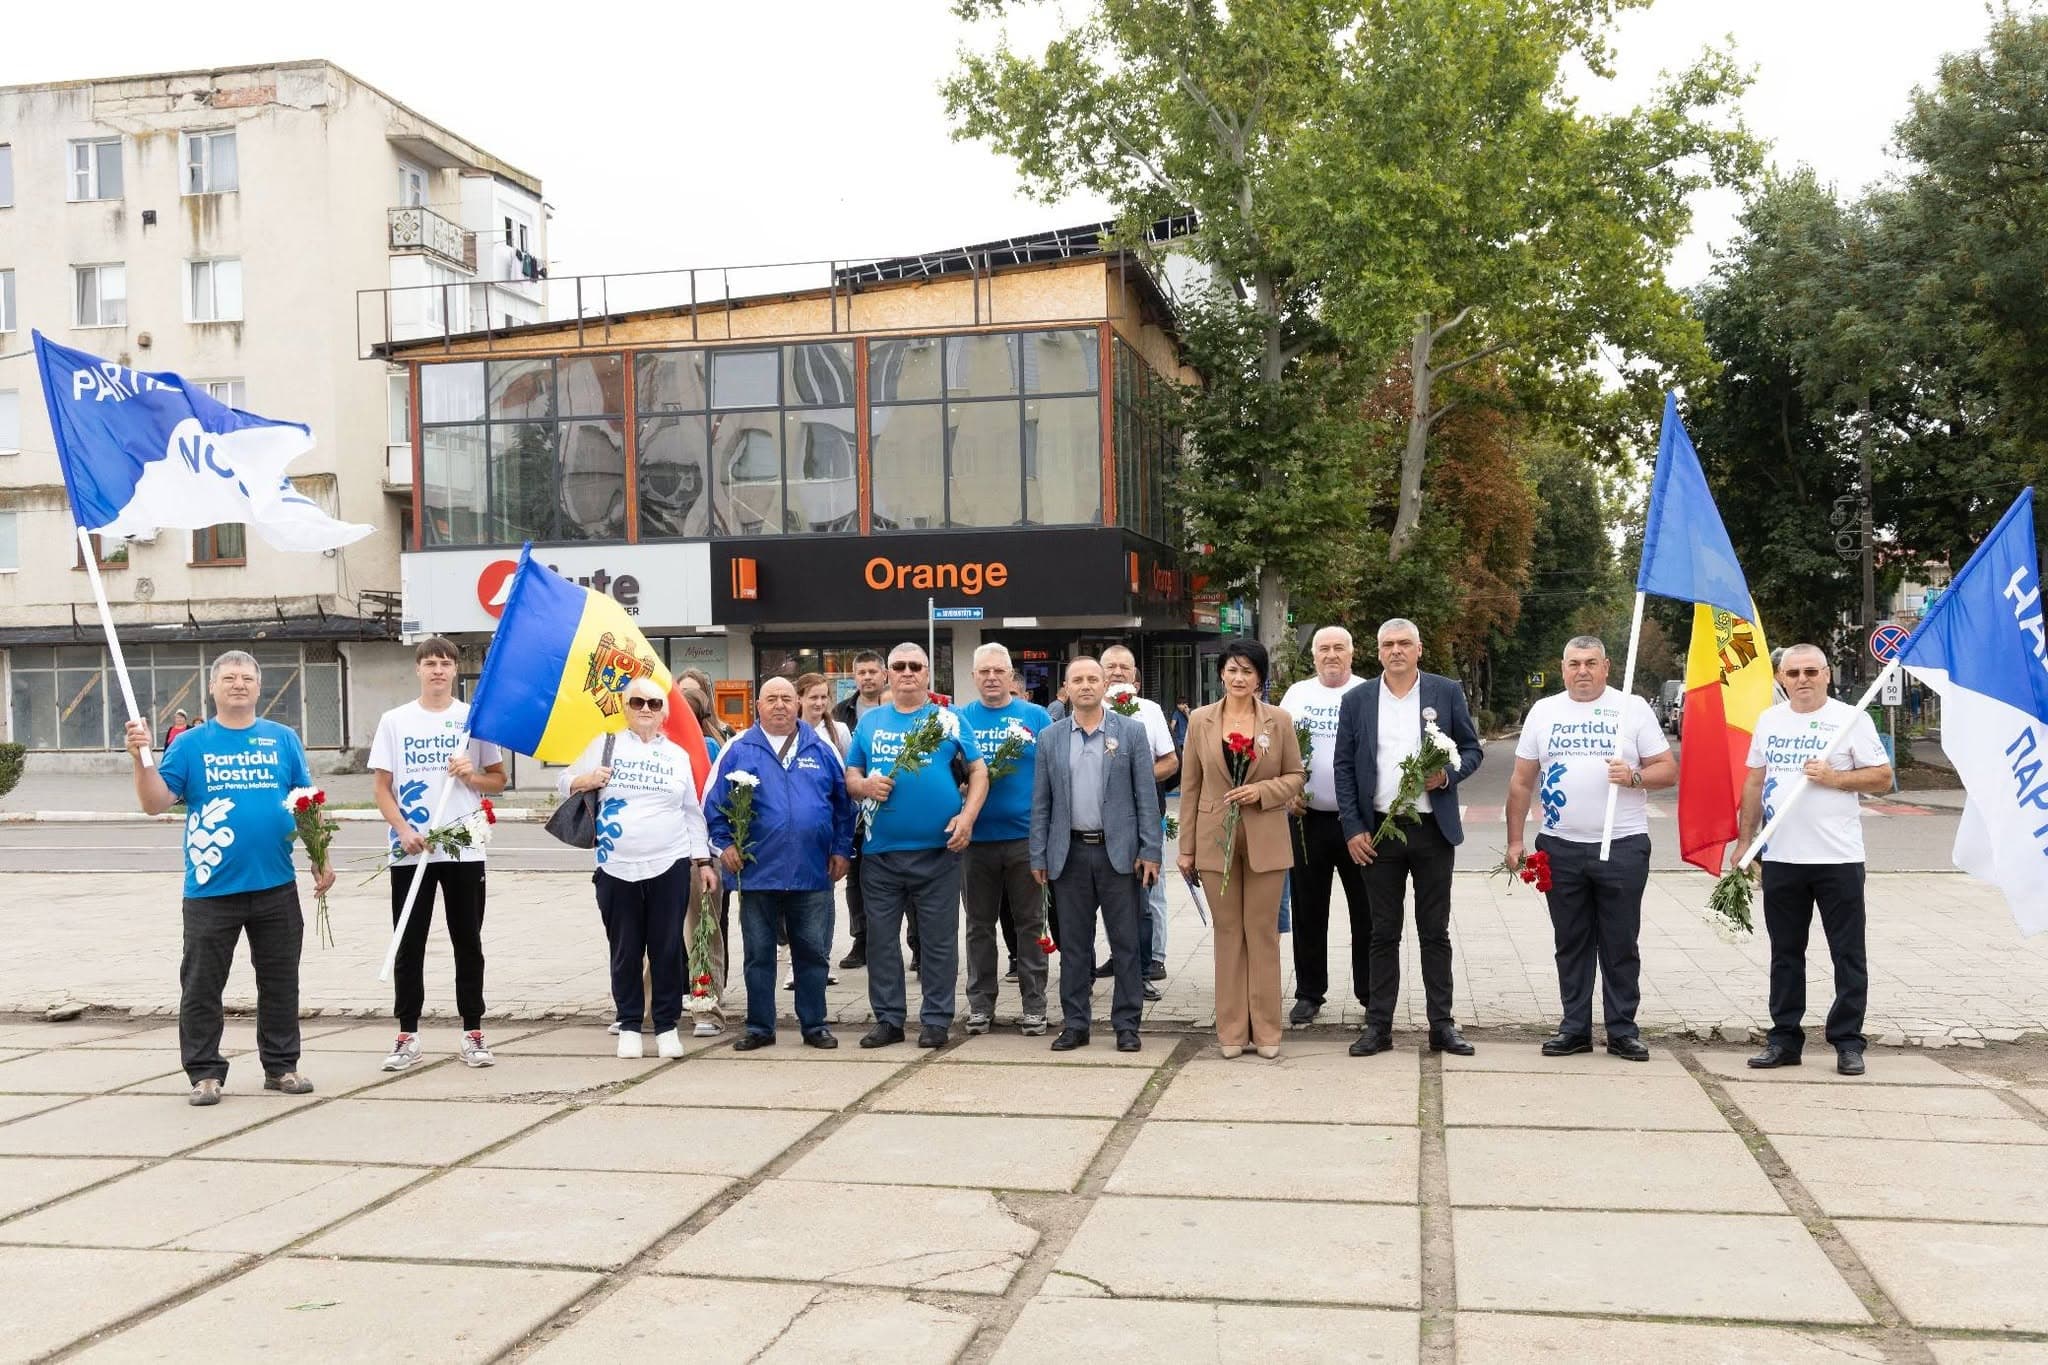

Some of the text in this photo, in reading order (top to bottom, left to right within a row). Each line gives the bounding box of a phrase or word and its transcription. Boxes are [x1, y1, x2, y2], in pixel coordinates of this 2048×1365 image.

[865, 557, 1007, 595] Orange
[1887, 685, 1898, 694] 50
[1304, 705, 1339, 717] Parti
[404, 733, 462, 751] Partid
[872, 729, 911, 743] Part
[1766, 734, 1829, 750] Partidu
[203, 750, 279, 767] Partidul
[404, 750, 453, 766] Nostr
[205, 766, 275, 783] Nostru.
[613, 758, 674, 776] Partidul
